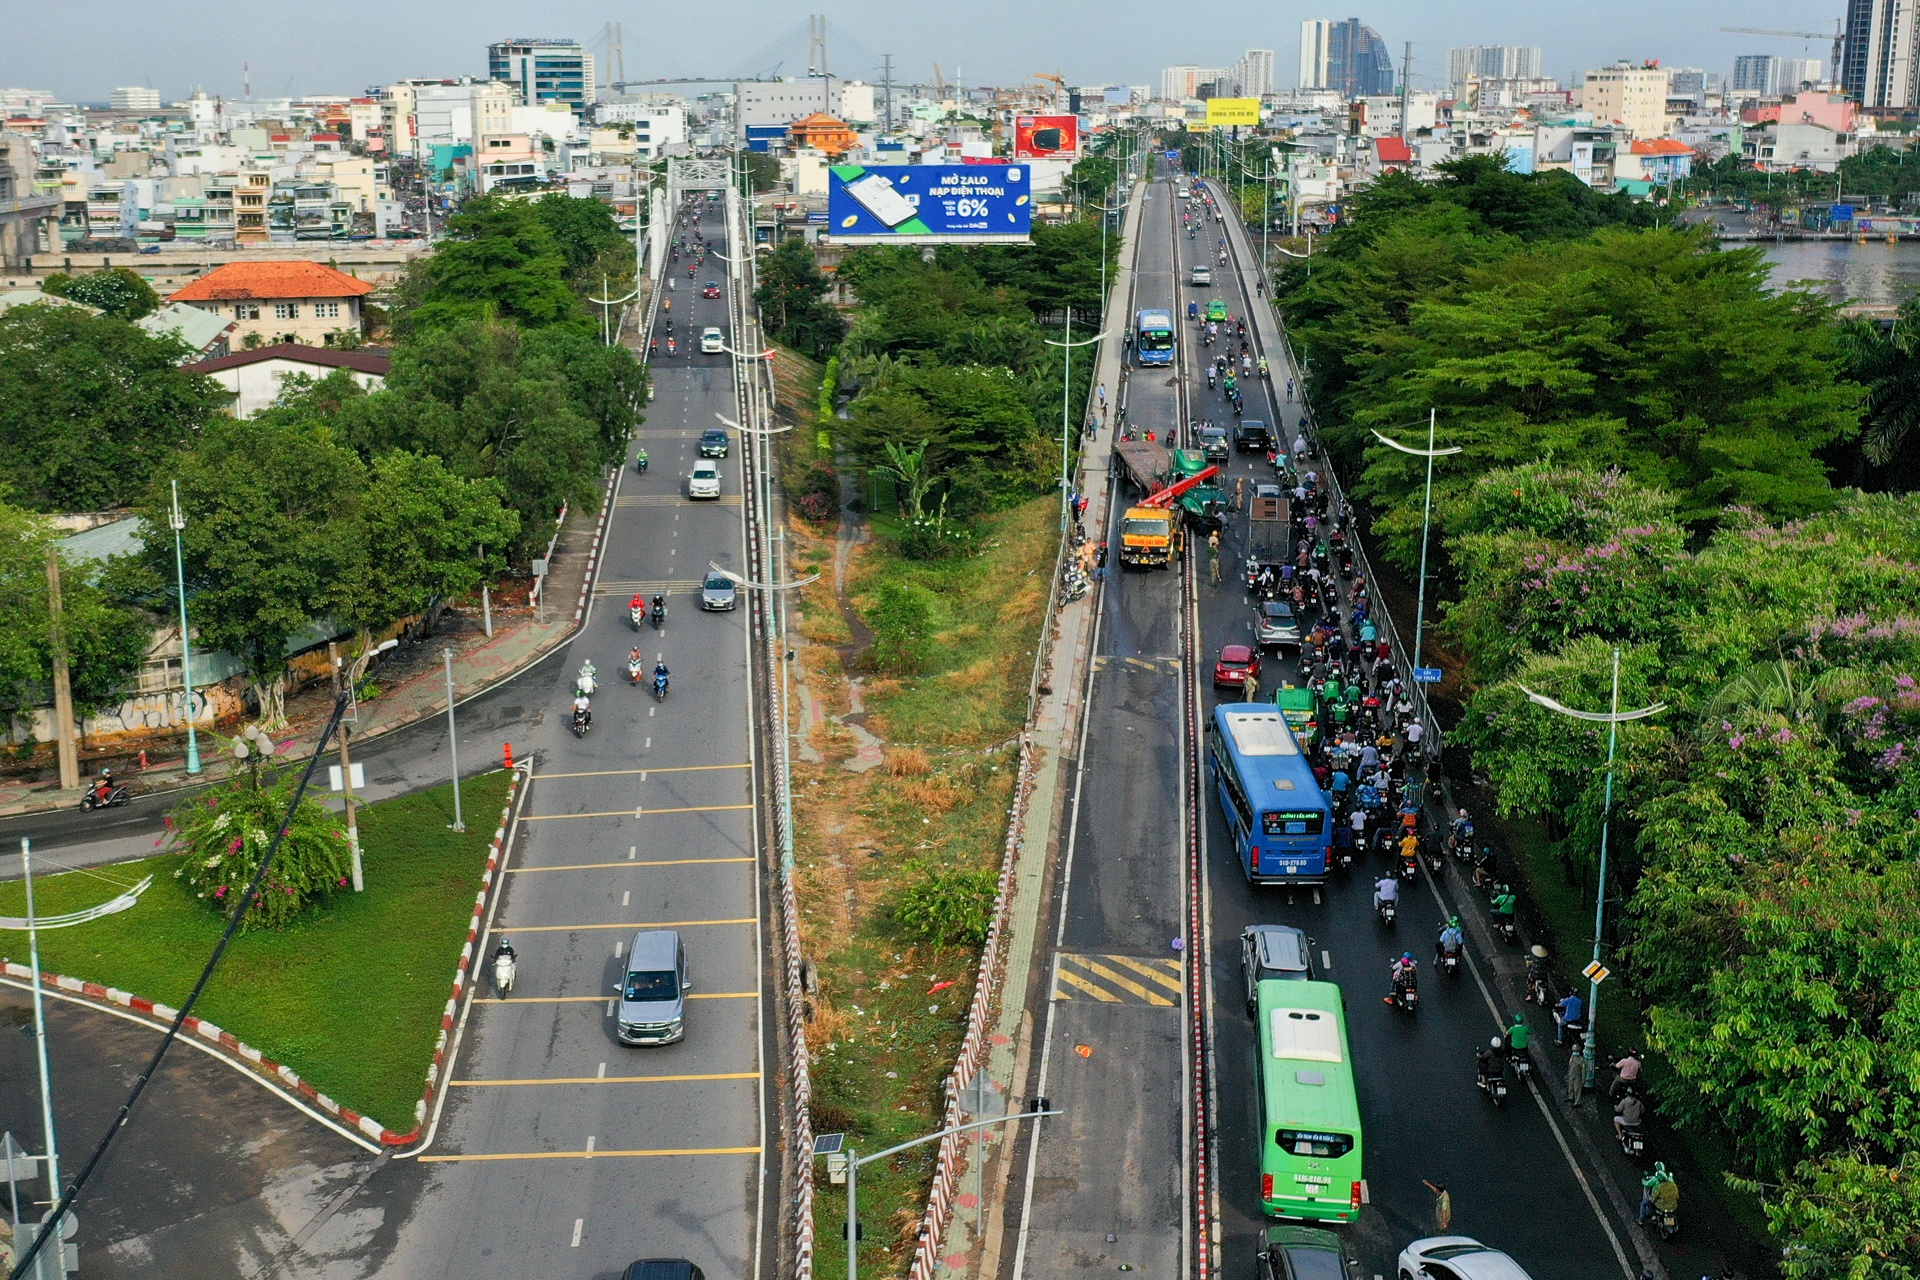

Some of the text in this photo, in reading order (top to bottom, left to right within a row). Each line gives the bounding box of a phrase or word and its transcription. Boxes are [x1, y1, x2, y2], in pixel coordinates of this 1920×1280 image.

[960, 176, 988, 185] ZALO
[929, 187, 950, 198] NẠP
[974, 187, 1004, 198] THOẠI
[957, 198, 989, 217] 6%
